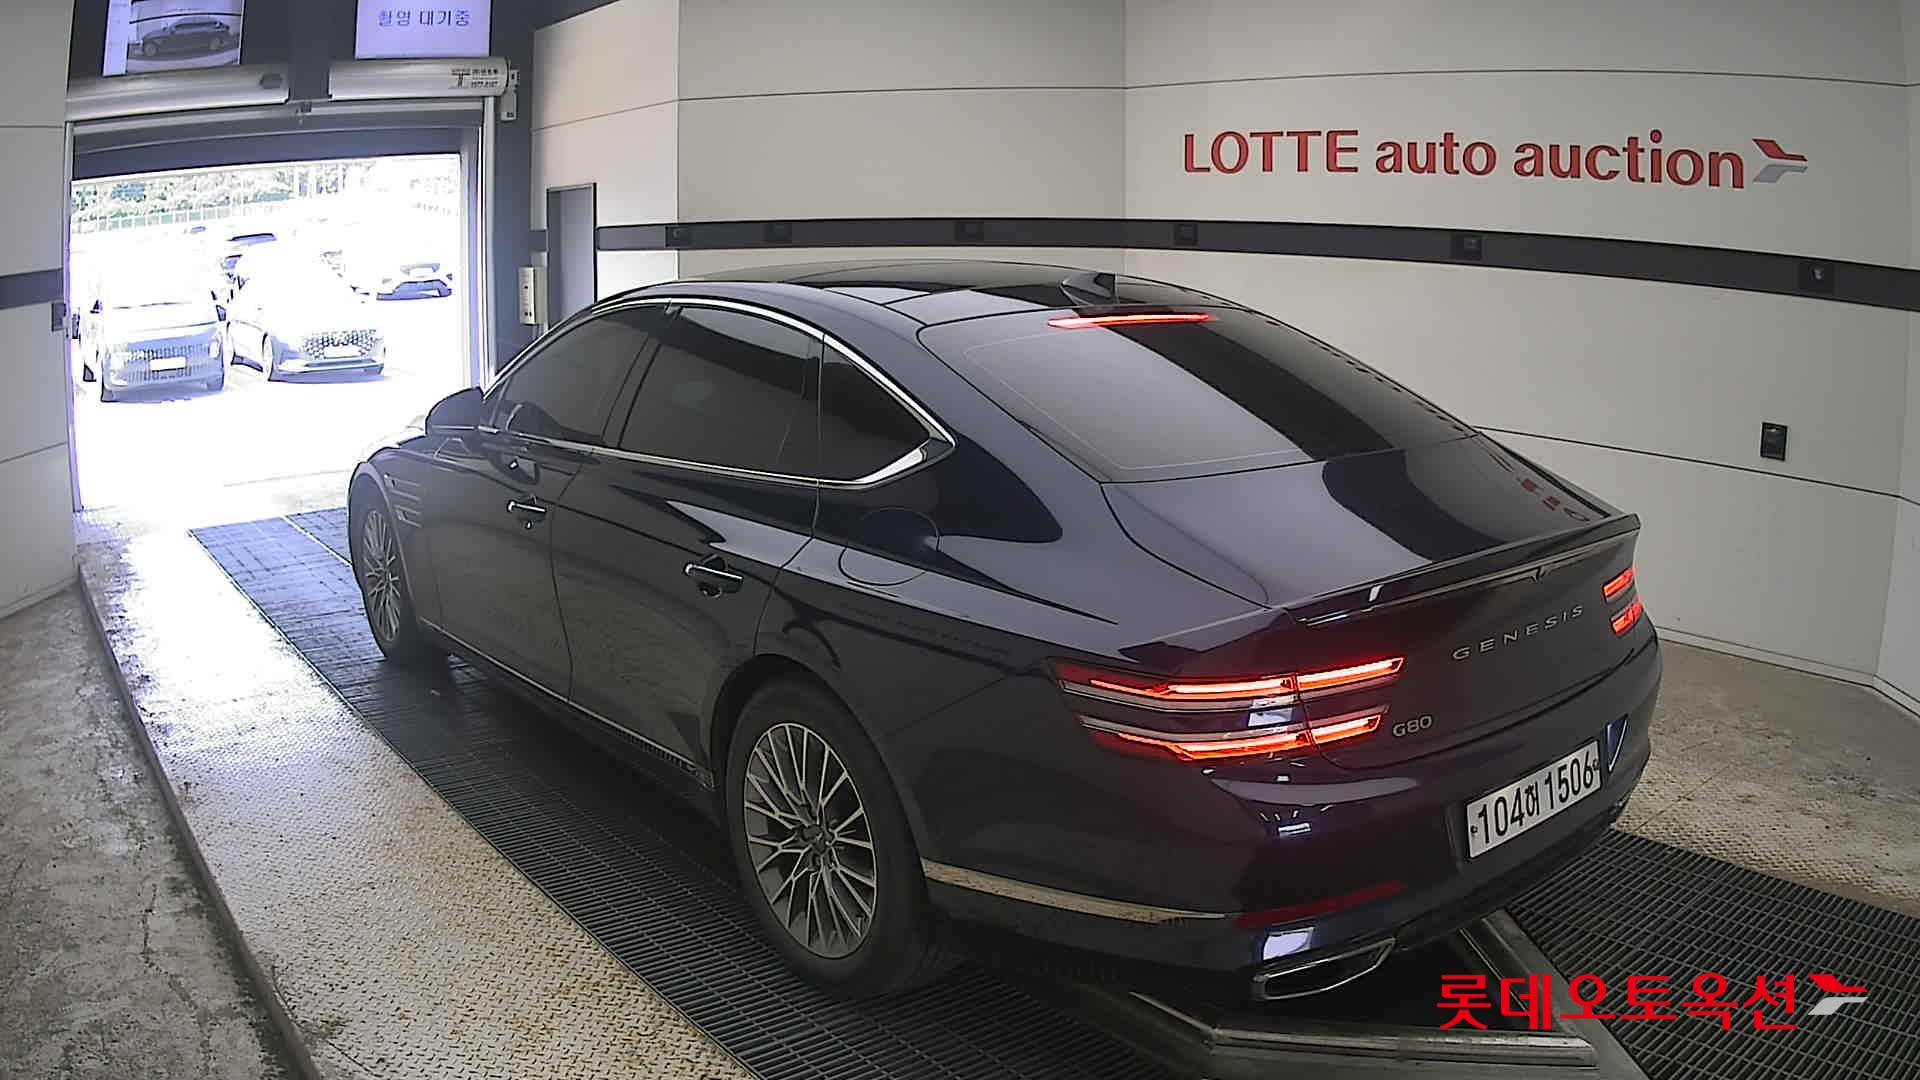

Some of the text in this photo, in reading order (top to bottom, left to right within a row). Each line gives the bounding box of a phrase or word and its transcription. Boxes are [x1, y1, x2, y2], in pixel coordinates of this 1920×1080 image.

[1184, 129, 1745, 189] LOTTE auto auction
[1451, 604, 1584, 661] GENESIS
[1392, 715, 1433, 737] G80
[1544, 751, 1594, 809] 1506
